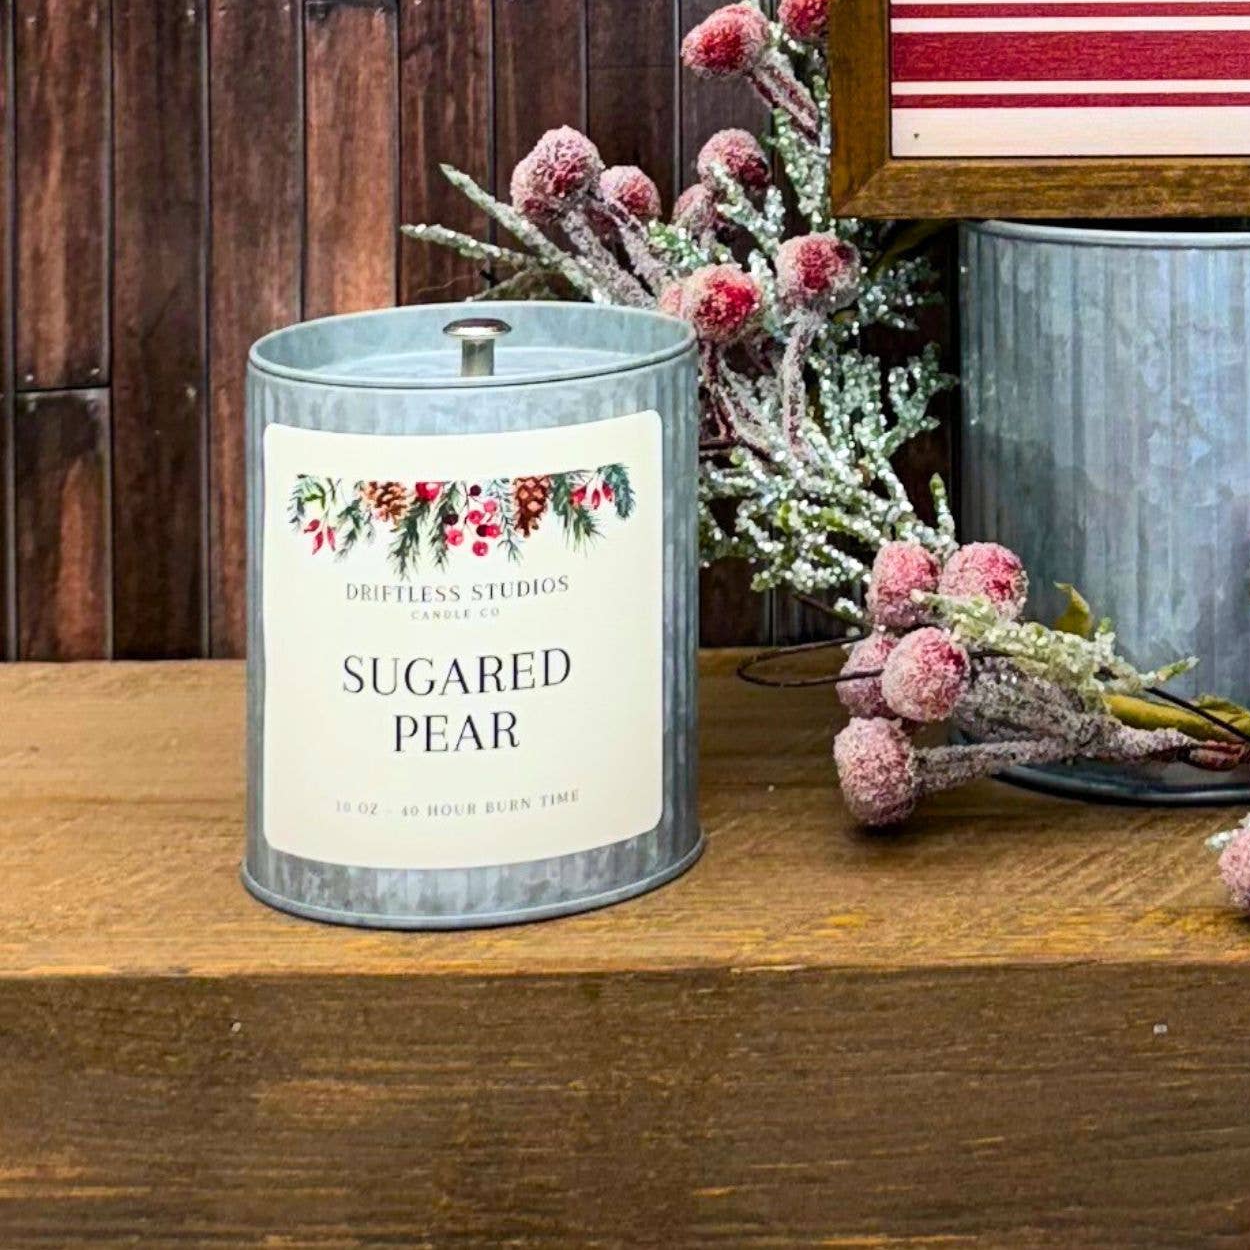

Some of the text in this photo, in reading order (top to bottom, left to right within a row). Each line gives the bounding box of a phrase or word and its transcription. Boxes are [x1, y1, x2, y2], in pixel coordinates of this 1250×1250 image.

[345, 575, 569, 603] DRIFTLESS STUDIOS
[410, 607, 500, 621] CANDLE CO
[342, 647, 572, 697] SUGARED
[393, 710, 521, 753] PEAR
[357, 801, 379, 816] OZ
[402, 805, 420, 817] 40
[426, 800, 477, 817] HOUR
[485, 796, 532, 814] BURN
[539, 789, 580, 808] TIME
